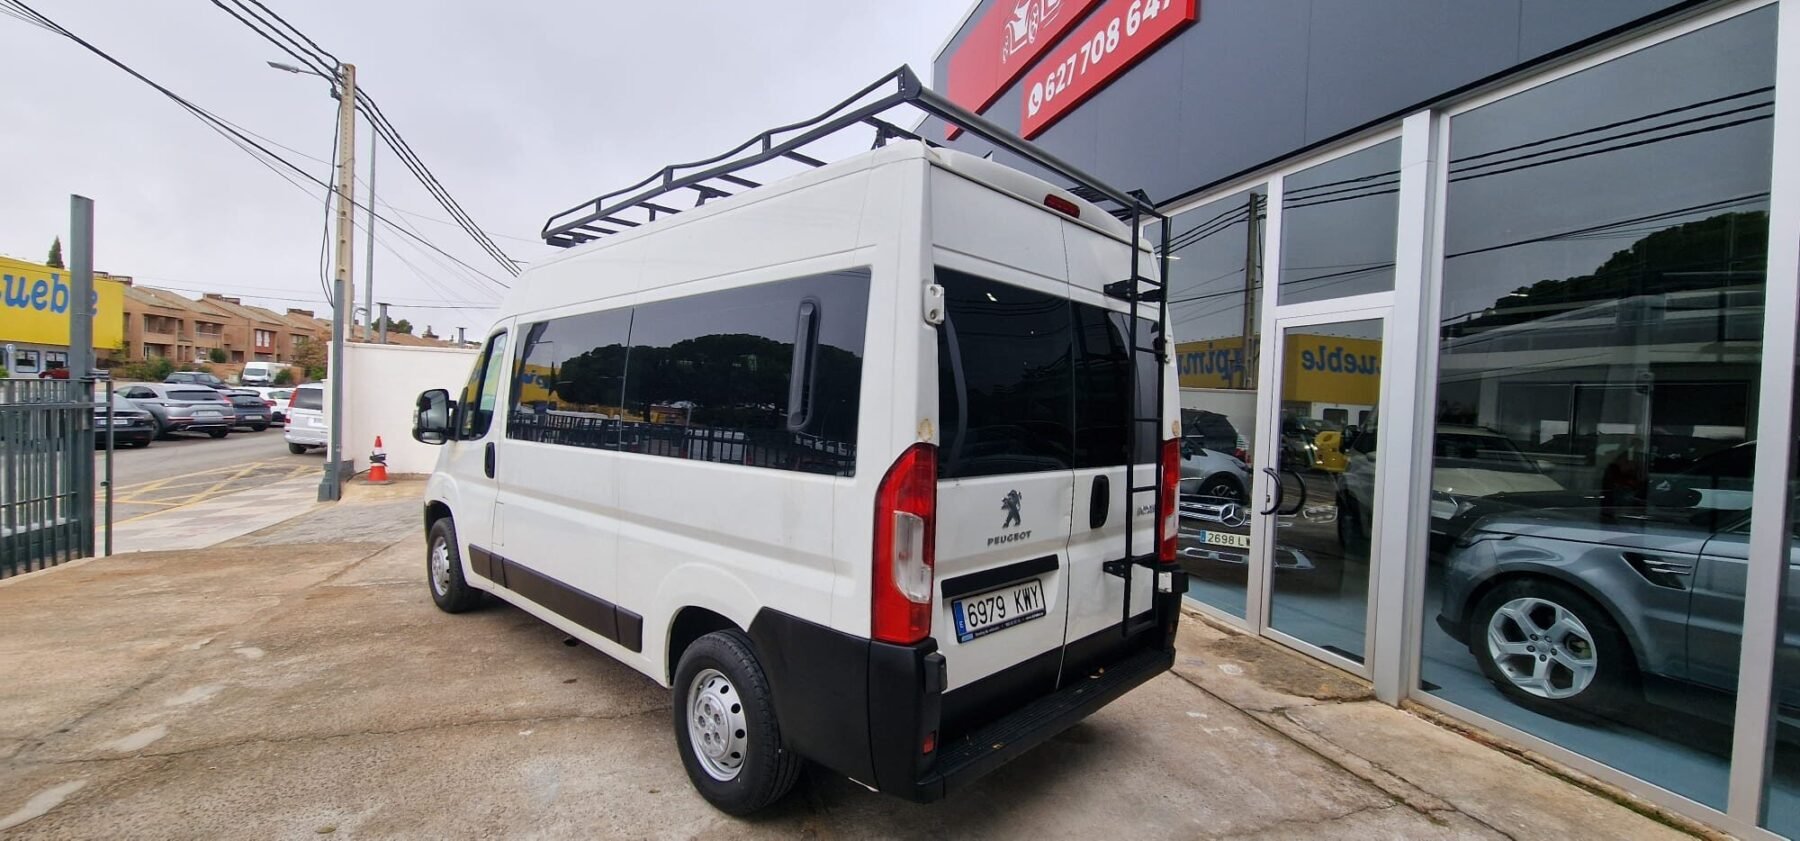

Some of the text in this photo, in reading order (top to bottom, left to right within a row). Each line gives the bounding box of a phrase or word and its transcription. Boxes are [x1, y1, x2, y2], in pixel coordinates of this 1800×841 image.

[1045, 53, 1077, 101] 627
[1080, 17, 1120, 75] 708
[987, 530, 1032, 546] PEUGEOT
[1208, 533, 1235, 545] 2698
[967, 595, 1006, 627] 6979
[1013, 585, 1039, 614] KWY
